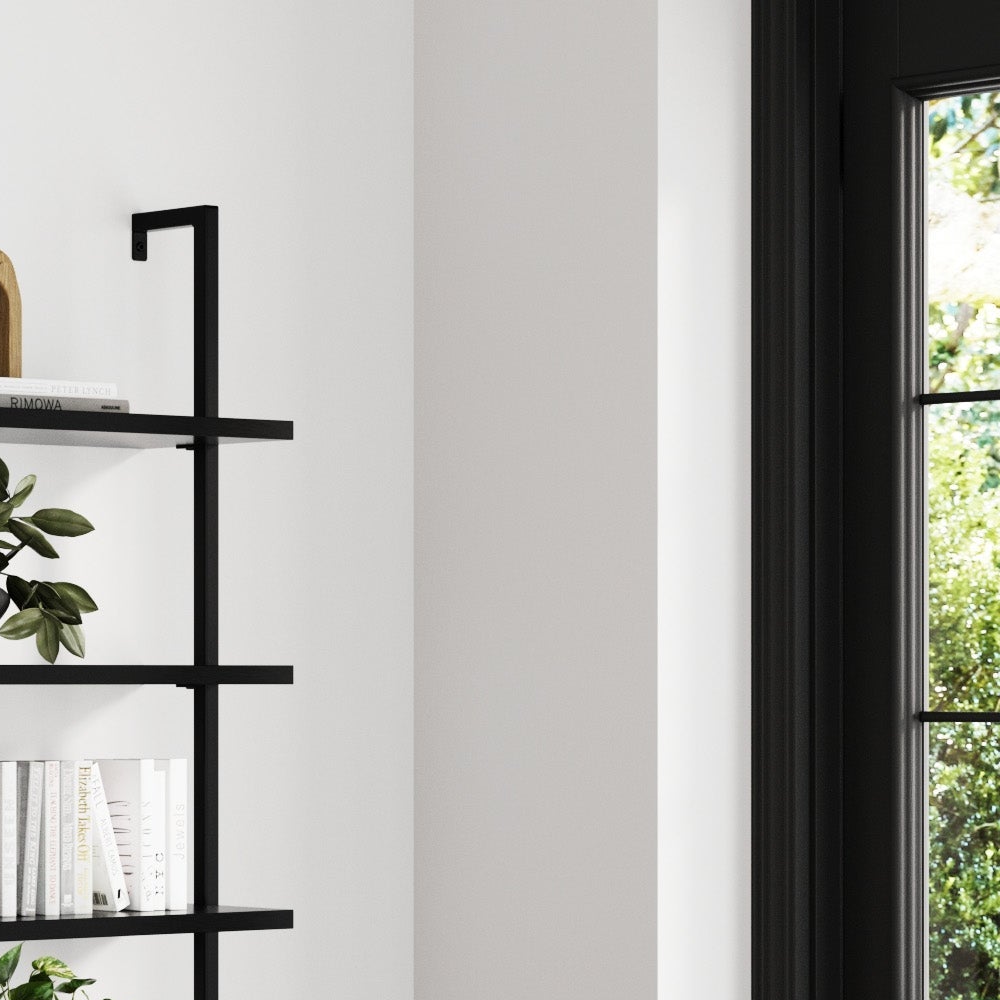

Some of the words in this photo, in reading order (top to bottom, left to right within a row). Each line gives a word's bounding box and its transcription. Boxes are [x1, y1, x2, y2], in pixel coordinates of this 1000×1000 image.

[10, 396, 62, 411] RIMOWA
[51, 385, 79, 394] PETER
[82, 386, 111, 396] LYNCH
[77, 766, 91, 814] Elizabeth
[173, 803, 185, 860] Jewels
